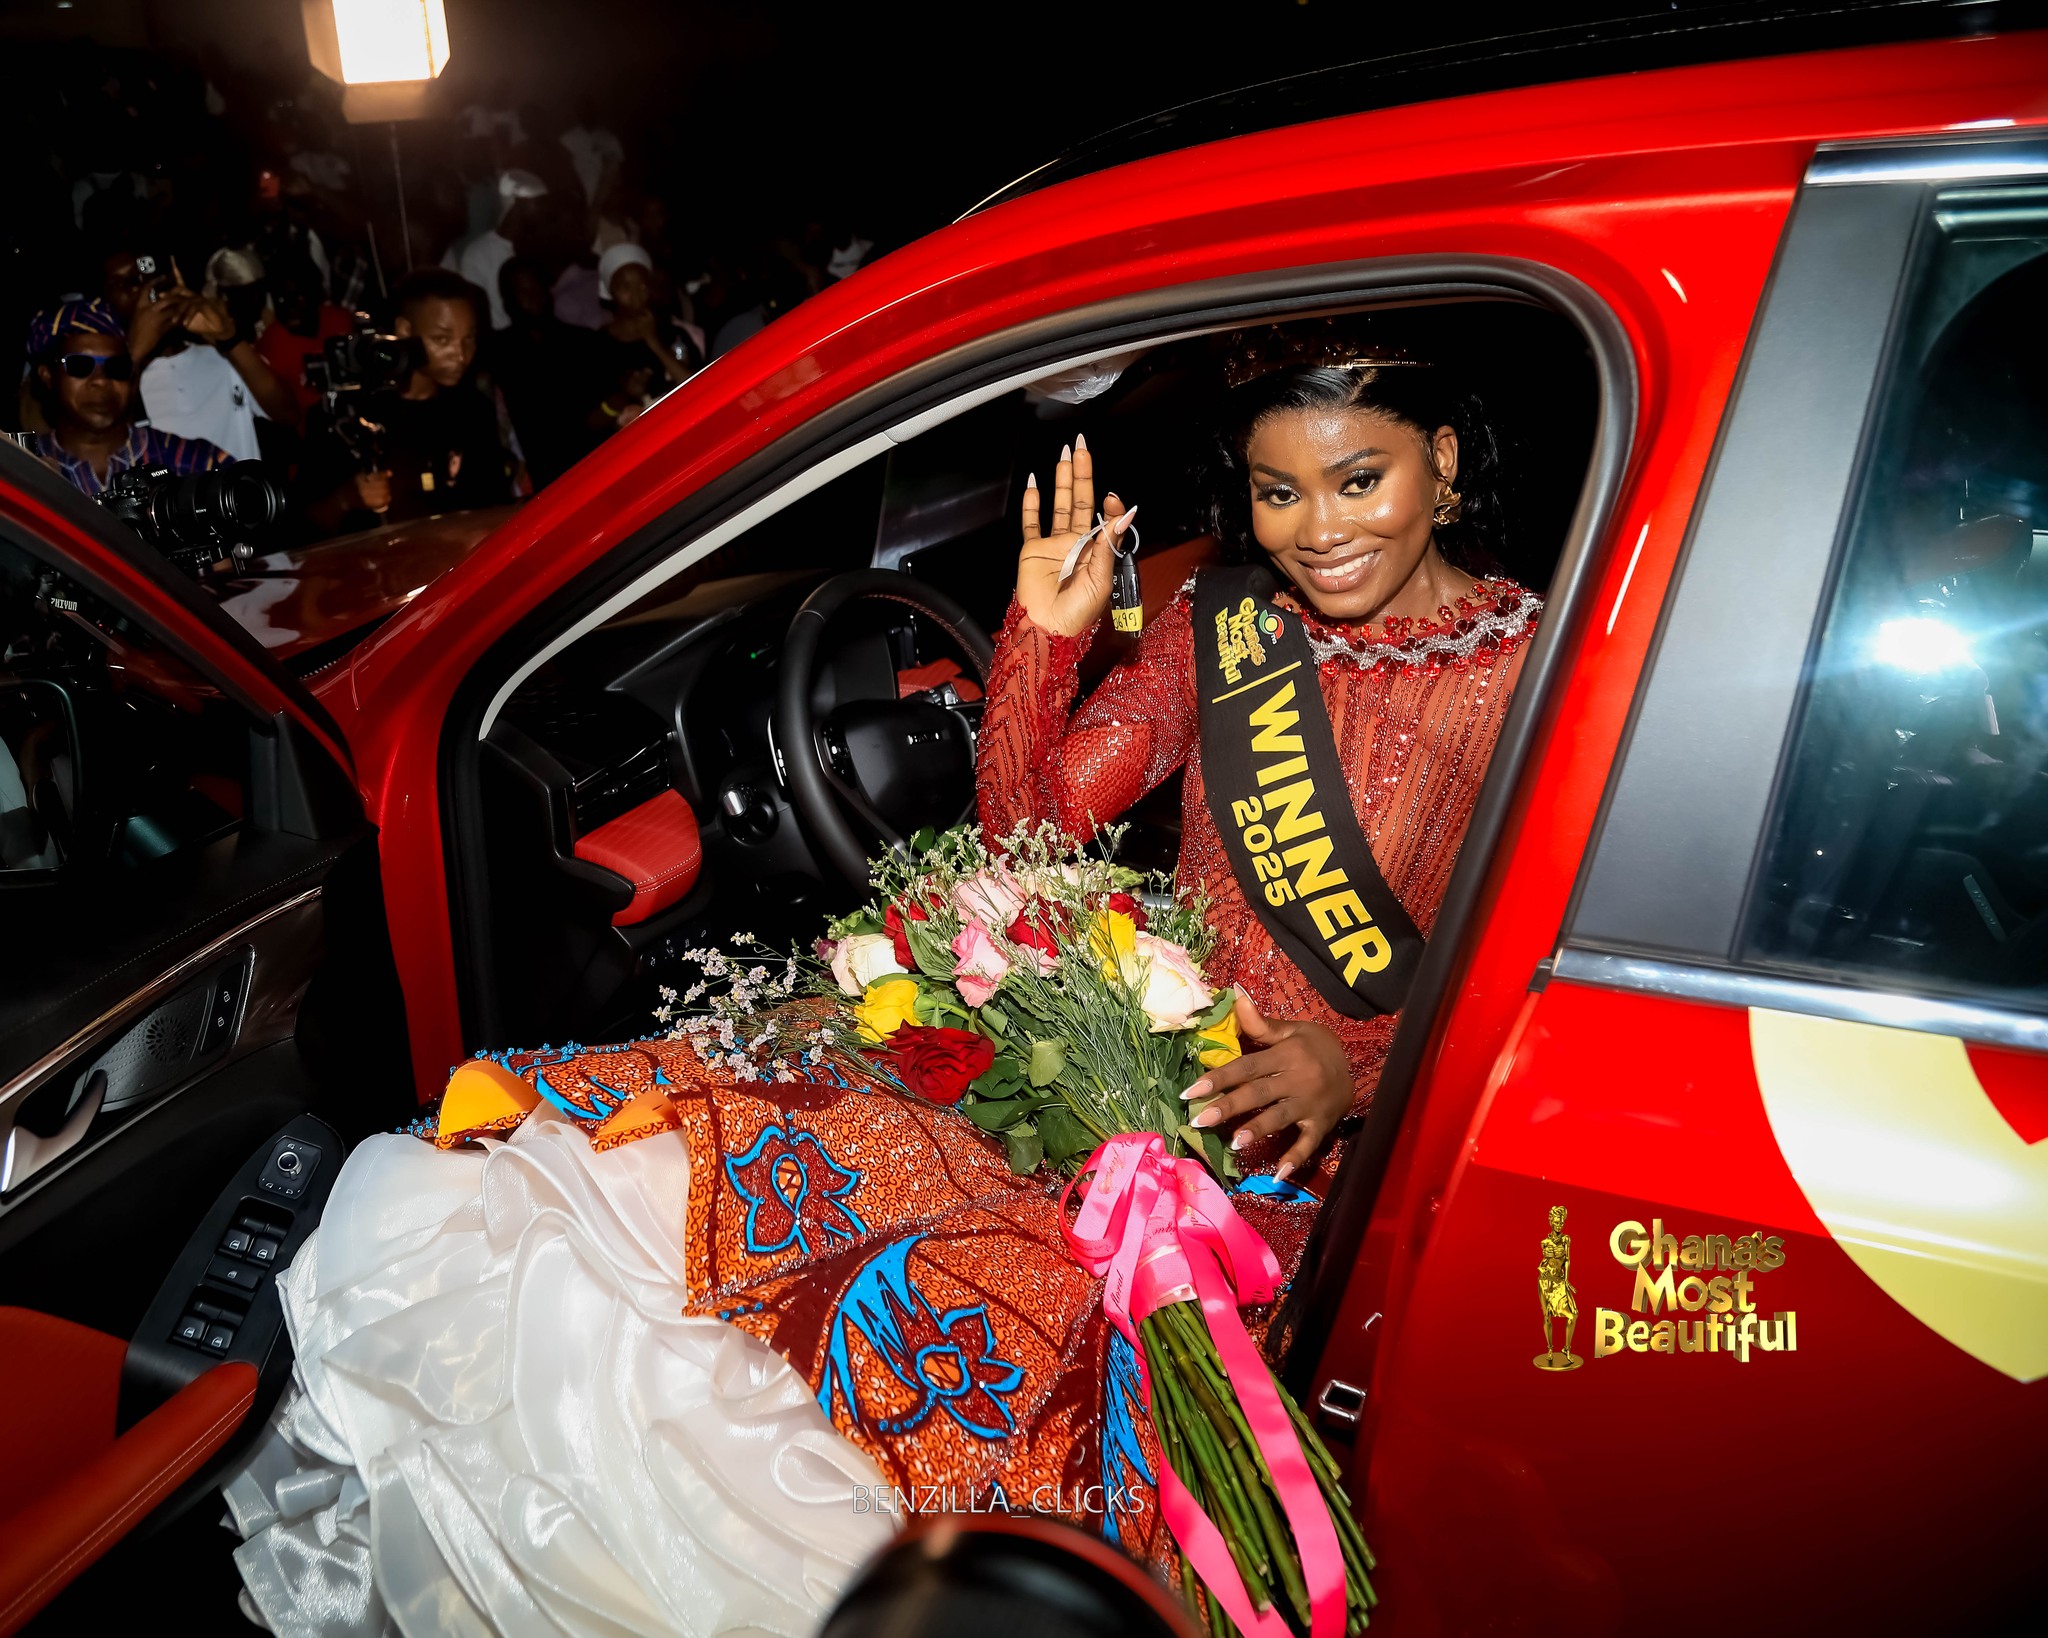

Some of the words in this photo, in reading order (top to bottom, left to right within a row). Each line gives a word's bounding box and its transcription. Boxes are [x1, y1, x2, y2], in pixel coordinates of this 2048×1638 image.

[151, 469, 168, 477] SONY
[1215, 607, 1242, 684] Beautiful
[1228, 613, 1250, 663] Most
[1239, 597, 1266, 666] Ghana's
[1231, 795, 1297, 908] 2025
[1249, 680, 1392, 988] WINNER
[1609, 1218, 1786, 1273] Ghana's
[1631, 1261, 1757, 1316] Most
[1594, 1307, 1797, 1363] Beautiful
